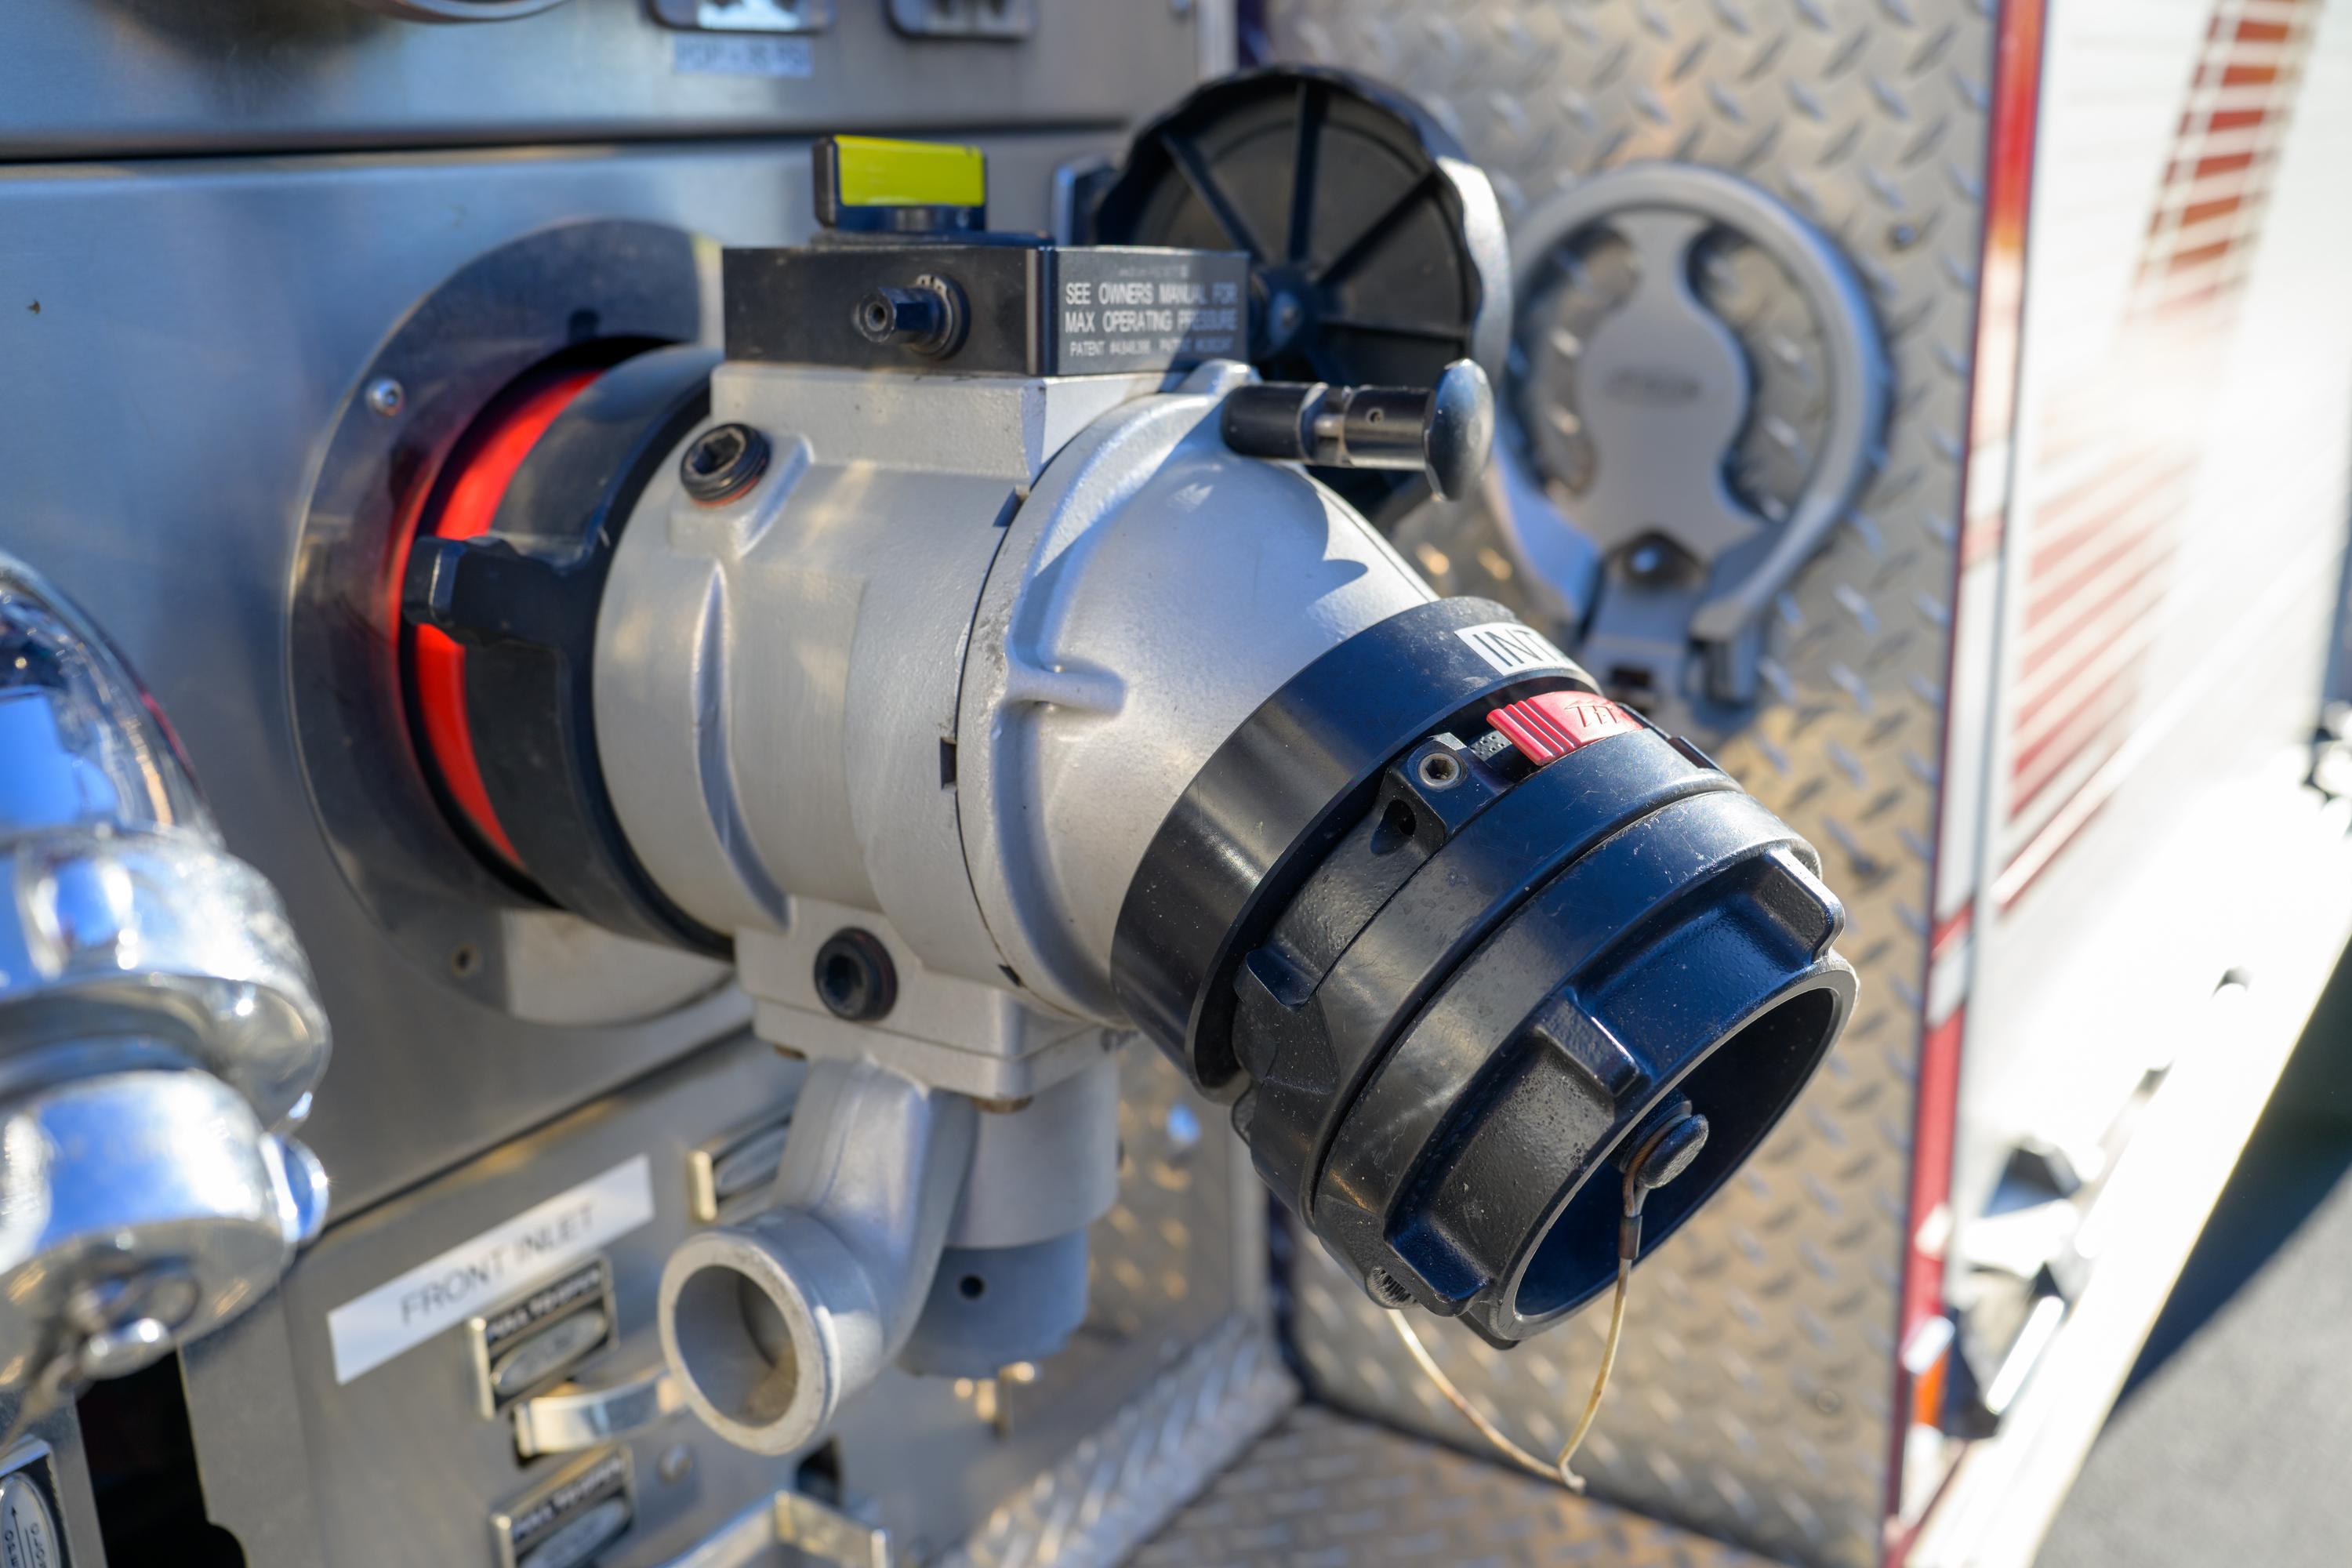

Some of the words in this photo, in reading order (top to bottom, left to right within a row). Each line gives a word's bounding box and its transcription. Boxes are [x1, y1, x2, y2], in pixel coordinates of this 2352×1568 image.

[1065, 283, 1091, 304] SEE
[1098, 282, 1154, 305] OWNERS
[1159, 282, 1206, 304] MANUAL
[1211, 282, 1238, 303] FOR
[1065, 311, 1095, 333] MAX
[1102, 310, 1173, 332] OPERATING
[1178, 310, 1237, 331] PRESSURE
[1069, 340, 1105, 358] PATENT
[399, 1243, 508, 1325] FRONT
[512, 1203, 595, 1263] INLET
